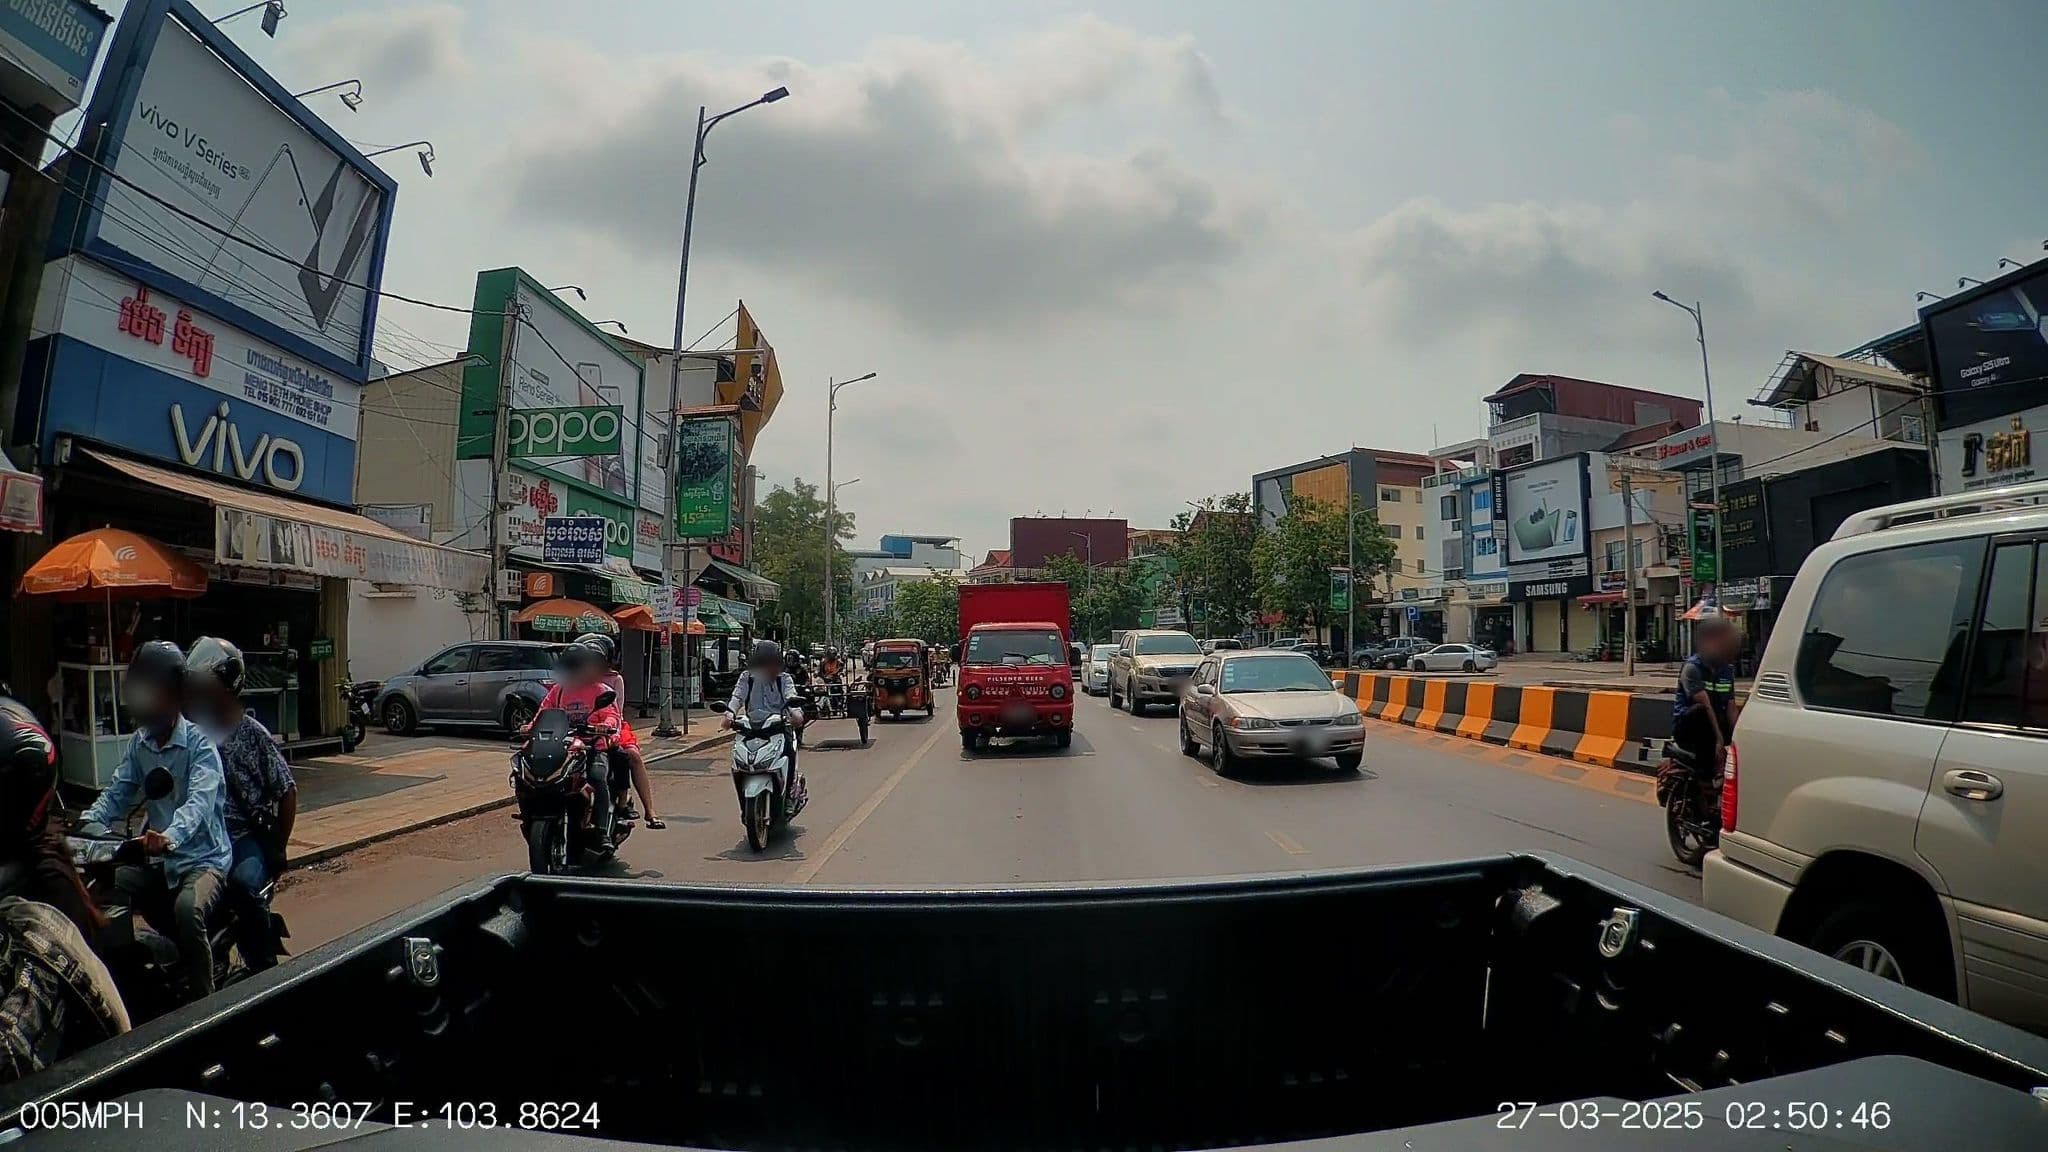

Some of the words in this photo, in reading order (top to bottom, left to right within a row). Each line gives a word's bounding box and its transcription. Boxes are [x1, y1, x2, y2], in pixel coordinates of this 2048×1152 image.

[140, 101, 179, 139] vivo
[184, 128, 197, 148] V
[196, 137, 238, 179] Series
[1960, 365, 1982, 379] Galaxy
[1994, 356, 2010, 367] Ultra
[243, 385, 257, 399] TEL
[244, 372, 268, 392] MENG
[268, 381, 289, 400] TETH
[289, 390, 314, 410] PHONE
[313, 400, 333, 416] SHOP
[535, 385, 554, 406] Series
[170, 398, 305, 493] vivo
[509, 410, 619, 454] oppo
[1525, 582, 1568, 597] SAMSUNG
